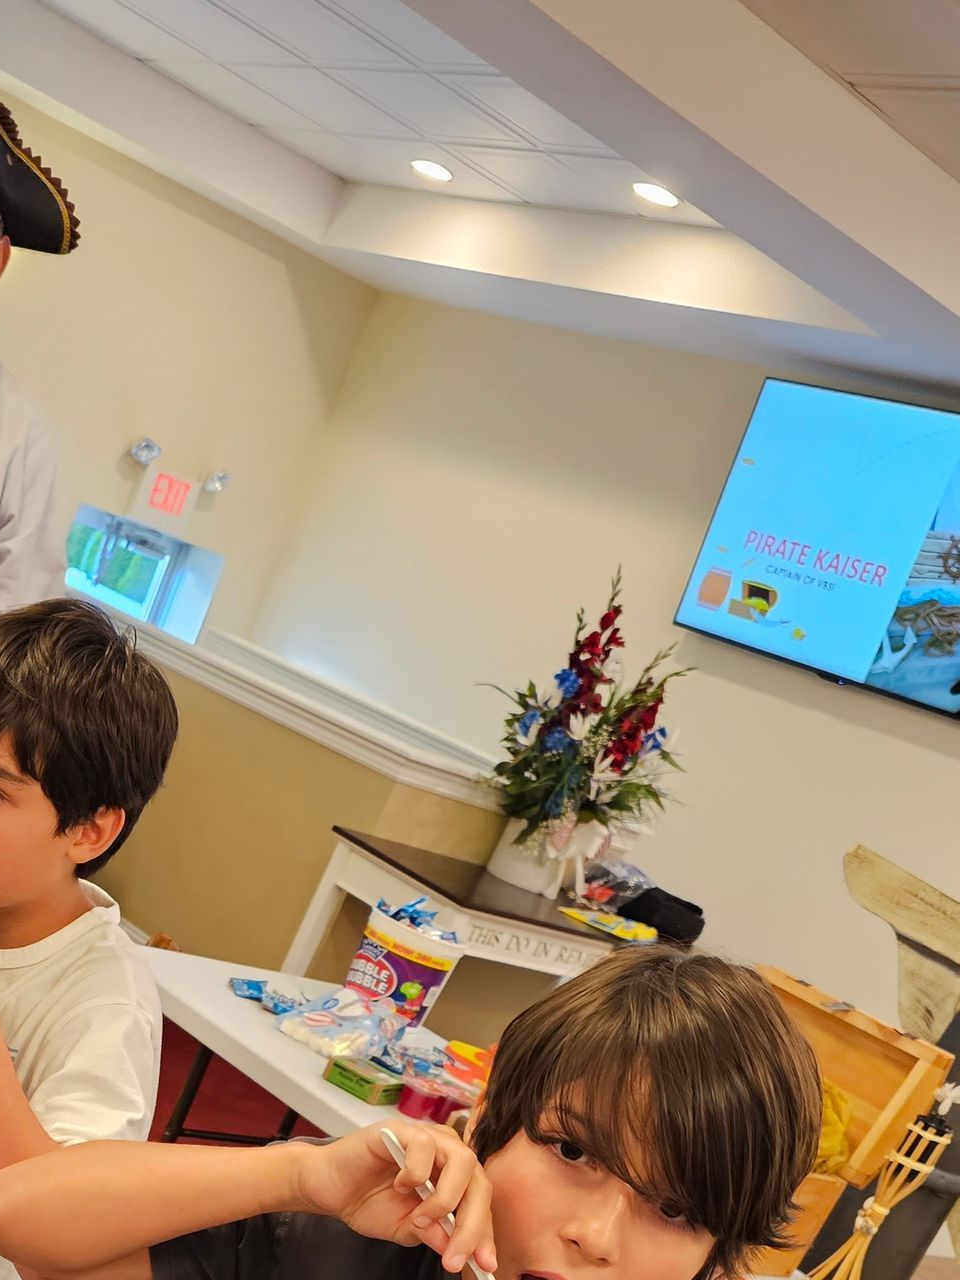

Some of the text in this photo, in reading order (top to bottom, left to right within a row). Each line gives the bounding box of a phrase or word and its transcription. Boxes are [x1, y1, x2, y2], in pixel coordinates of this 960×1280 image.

[149, 473, 192, 517] EXIT
[743, 530, 888, 587] PIRATE KAISER
[765, 565, 801, 582] CAPTAIN
[468, 925, 503, 947] THIS
[505, 934, 530, 952] DO
[532, 942, 552, 958] IN
